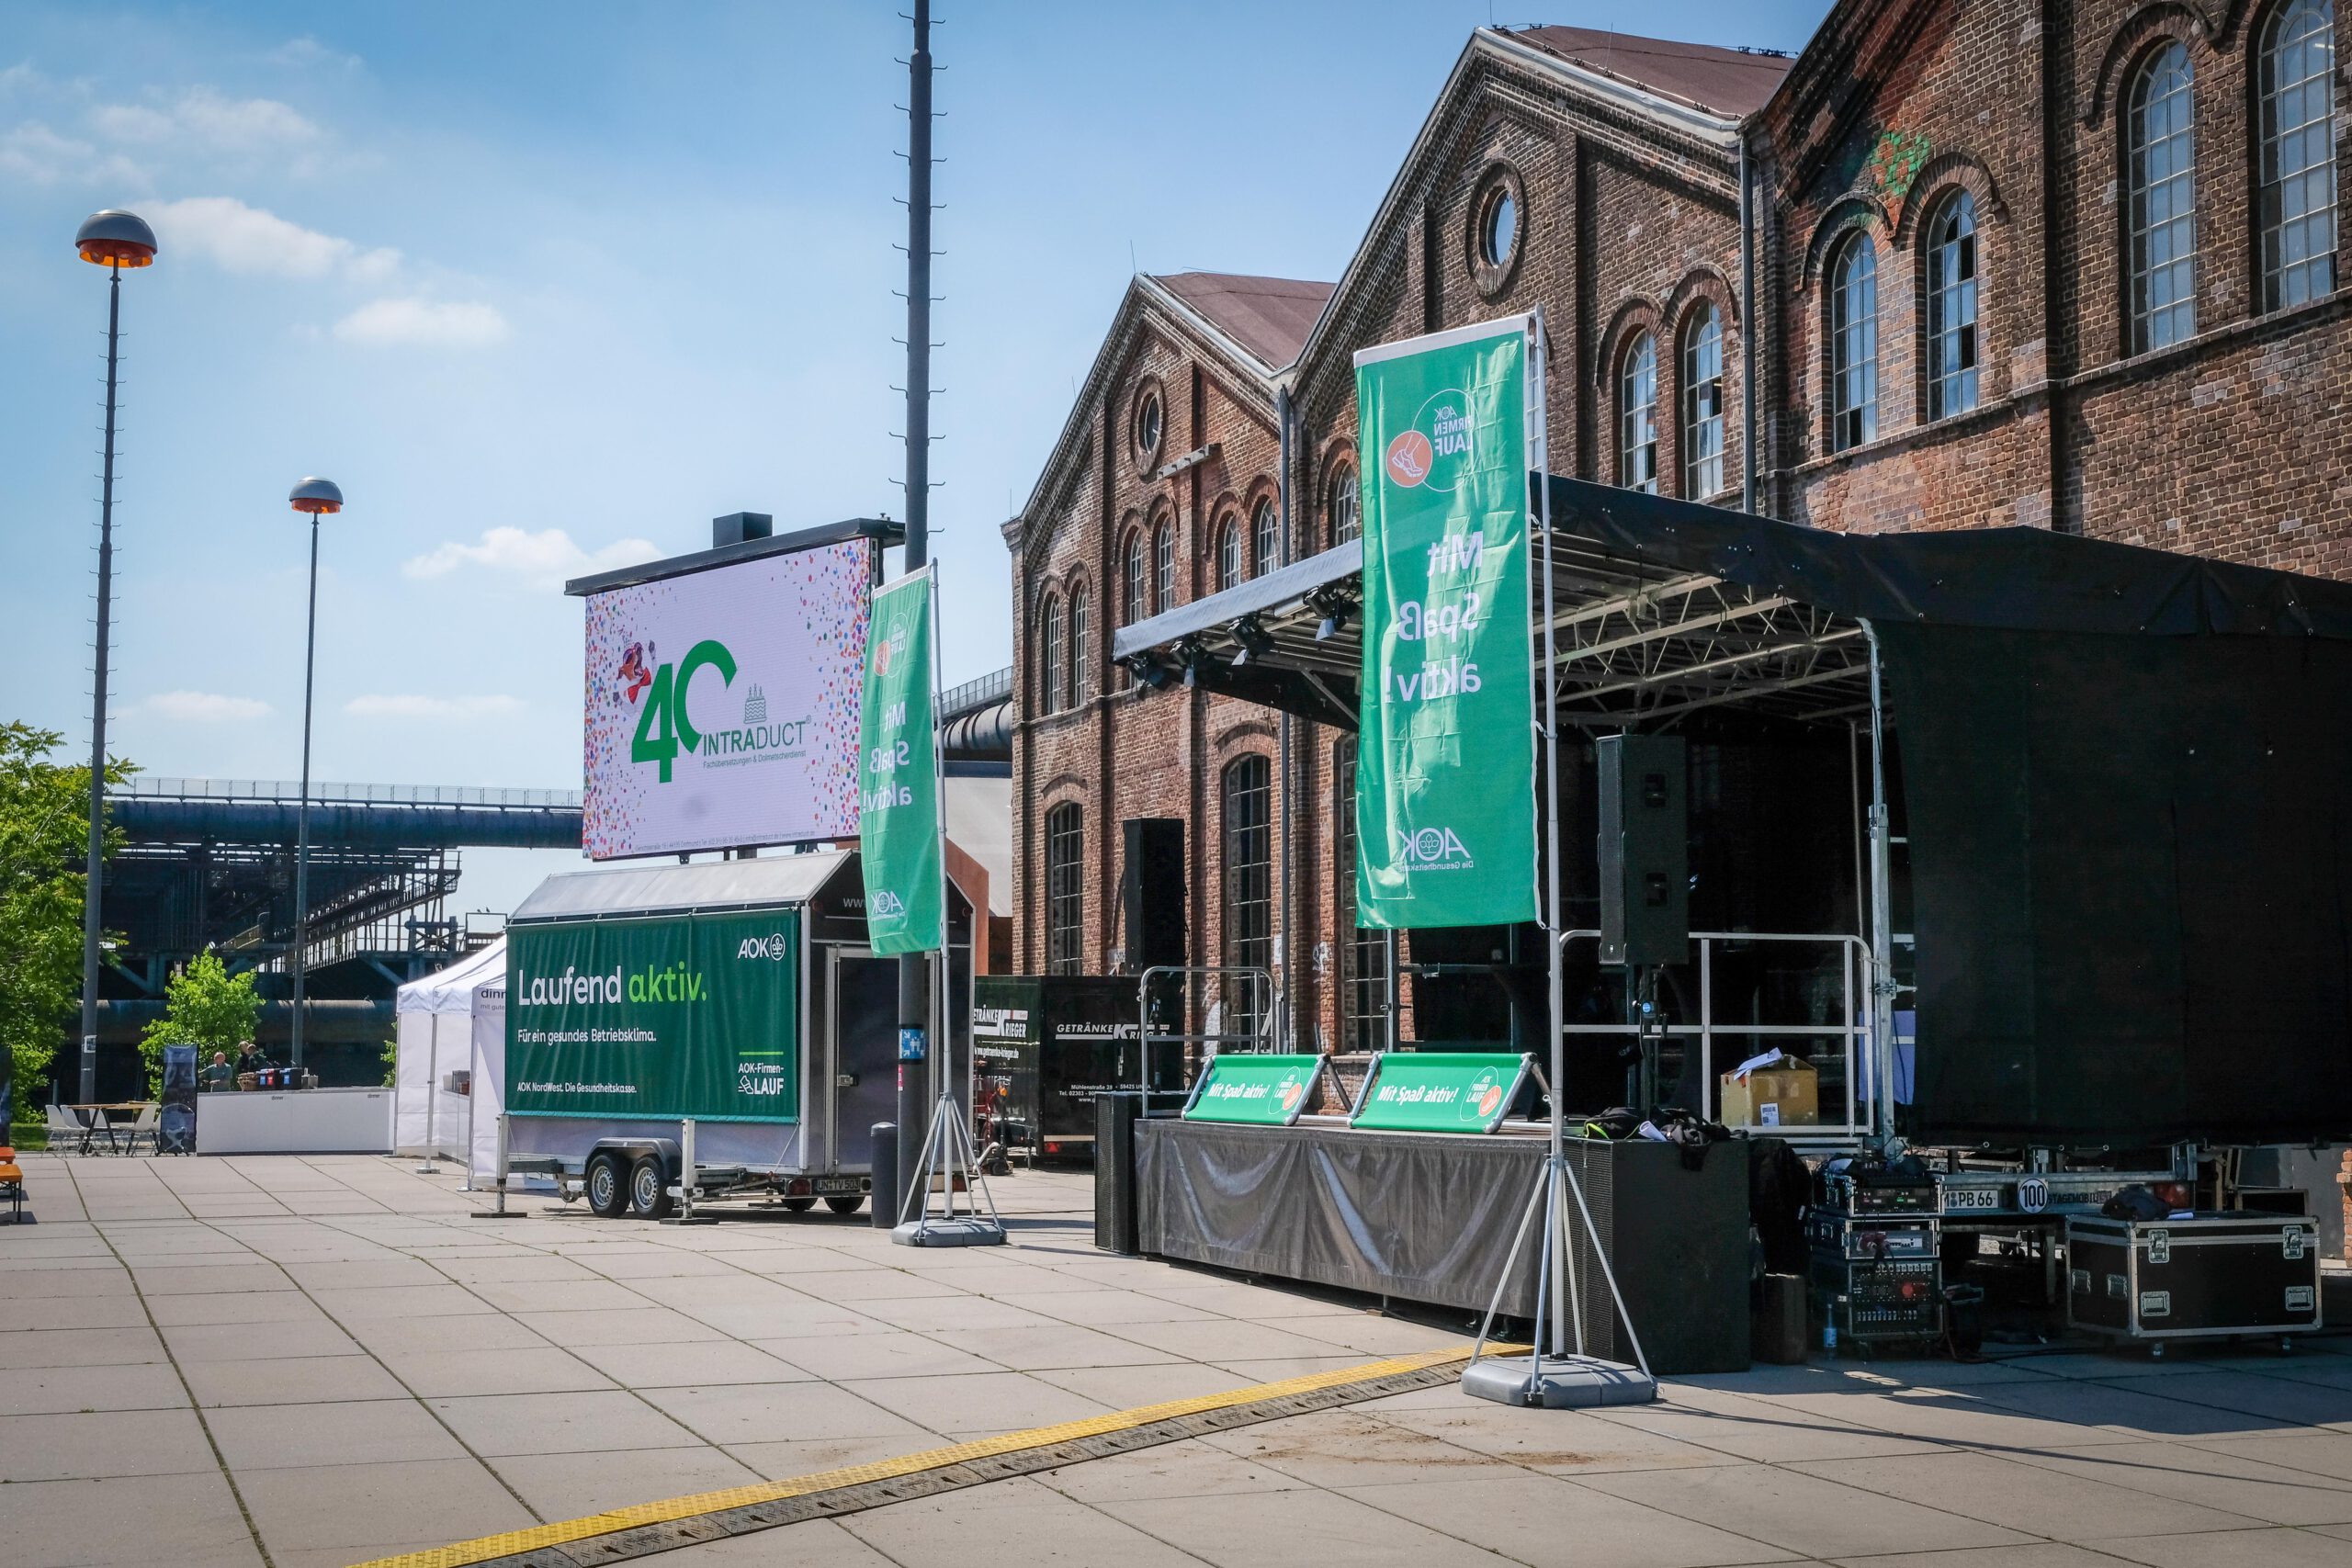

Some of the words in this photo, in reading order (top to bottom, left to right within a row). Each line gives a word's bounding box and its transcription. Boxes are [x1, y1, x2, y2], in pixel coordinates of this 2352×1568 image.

[737, 937, 770, 959] AOK
[518, 965, 622, 1006] Laufend
[628, 961, 707, 1003] aktiv.
[481, 988, 506, 999] dinn
[974, 1004, 999, 1023] ETRÄNKE
[517, 1029, 532, 1043] Für
[532, 1029, 547, 1043] ein
[548, 1028, 589, 1046] gesundes
[591, 1027, 657, 1043] Betriebsklima.
[1057, 1021, 1114, 1033] GETRÄNKE
[738, 1062, 785, 1074] AOK-Firmen-
[517, 1082, 532, 1092] AOK
[532, 1082, 564, 1093] NordWest.
[565, 1082, 576, 1093] Die
[576, 1082, 638, 1094] Gesundheitskasse.
[753, 1077, 785, 1096] LAUF
[1206, 1083, 1225, 1098] Mit
[1222, 1082, 1246, 1101] Spaß
[1242, 1083, 1271, 1099] aktiv!
[1376, 1085, 1398, 1101] Mit
[1396, 1085, 1426, 1106] Spaß
[1423, 1085, 1460, 1103] aktiv!
[1958, 1191, 1975, 1207] PB
[1977, 1191, 1993, 1207] 66
[2021, 1184, 2045, 1208] 100
